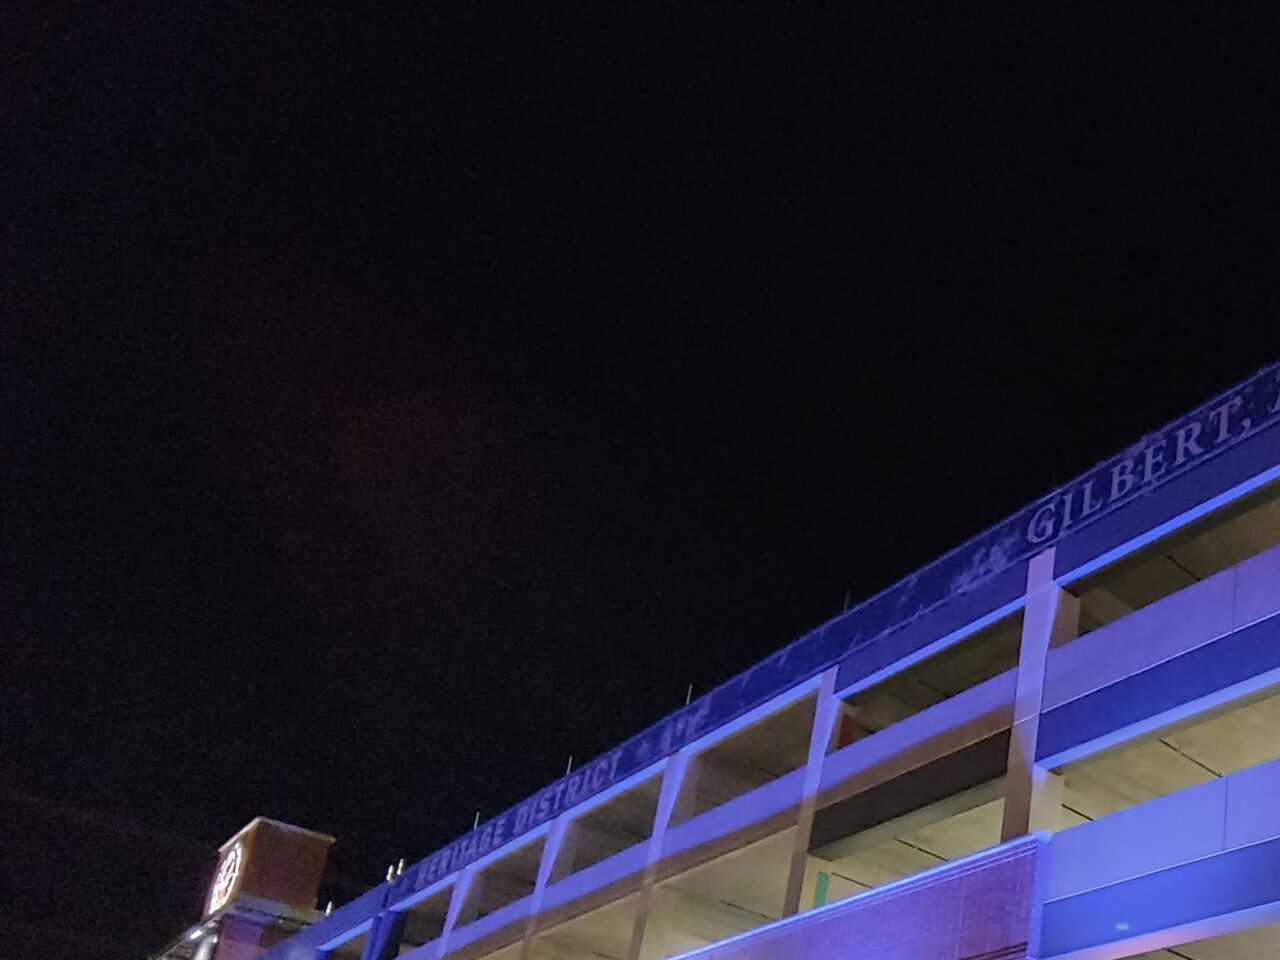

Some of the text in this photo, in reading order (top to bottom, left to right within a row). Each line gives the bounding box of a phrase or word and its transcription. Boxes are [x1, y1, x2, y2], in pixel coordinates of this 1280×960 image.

[1027, 393, 1251, 544] GILBERT,
[415, 750, 622, 890] HERITAGE DISTRICT
